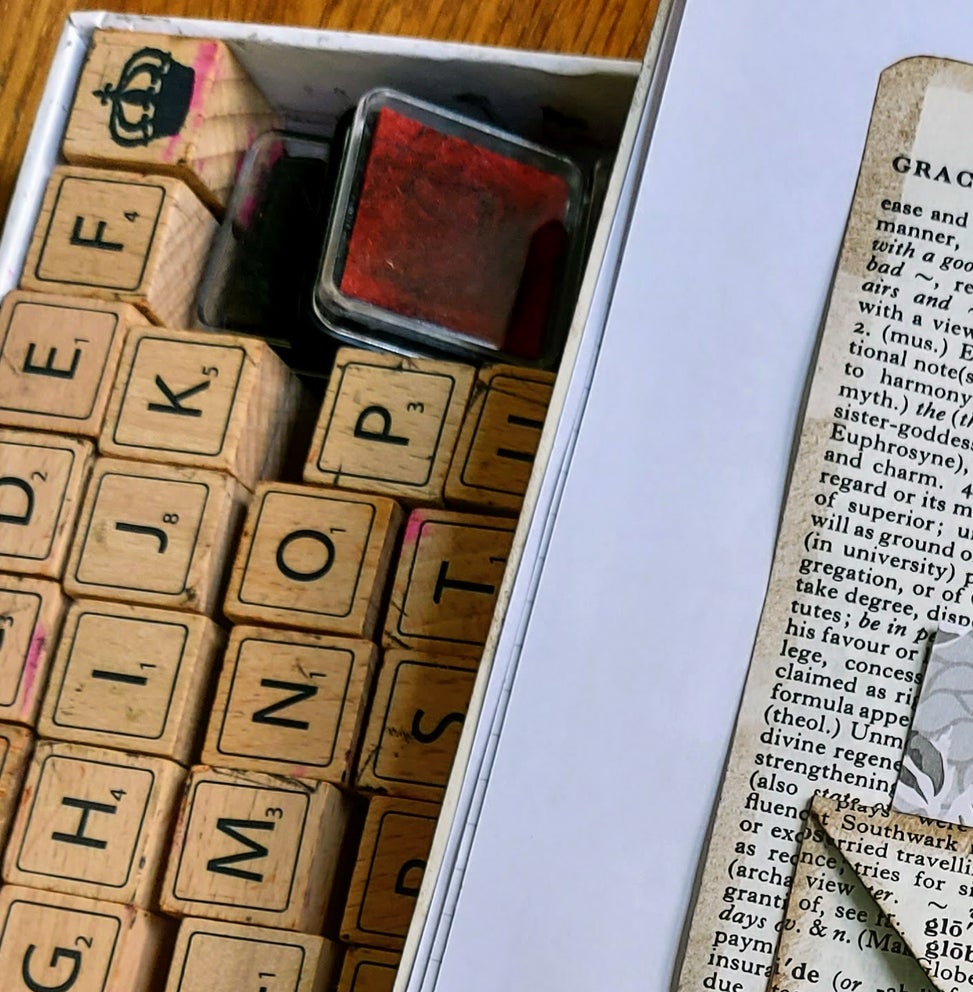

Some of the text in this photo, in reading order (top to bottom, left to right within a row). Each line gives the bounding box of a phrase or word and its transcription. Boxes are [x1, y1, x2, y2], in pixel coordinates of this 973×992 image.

[70, 212, 139, 251] F 4
[880, 198, 924, 218] ease
[930, 210, 969, 229] and
[874, 217, 960, 252] manner,
[858, 299, 904, 323] with
[911, 314, 923, 327] a
[848, 338, 908, 368] tional
[852, 321, 871, 337] 2.
[882, 324, 949, 359] (mus.)
[22, 343, 81, 379] E
[148, 367, 218, 417] K 5
[354, 402, 424, 446] P 3
[31, 471, 47, 481] 2
[116, 513, 179, 553] J 8
[276, 530, 335, 581] O
[433, 561, 495, 604] T
[92, 669, 148, 686] I
[252, 679, 316, 730] N
[52, 790, 126, 849] H 4
[207, 808, 283, 882] M 3
[75, 936, 93, 948] 2
